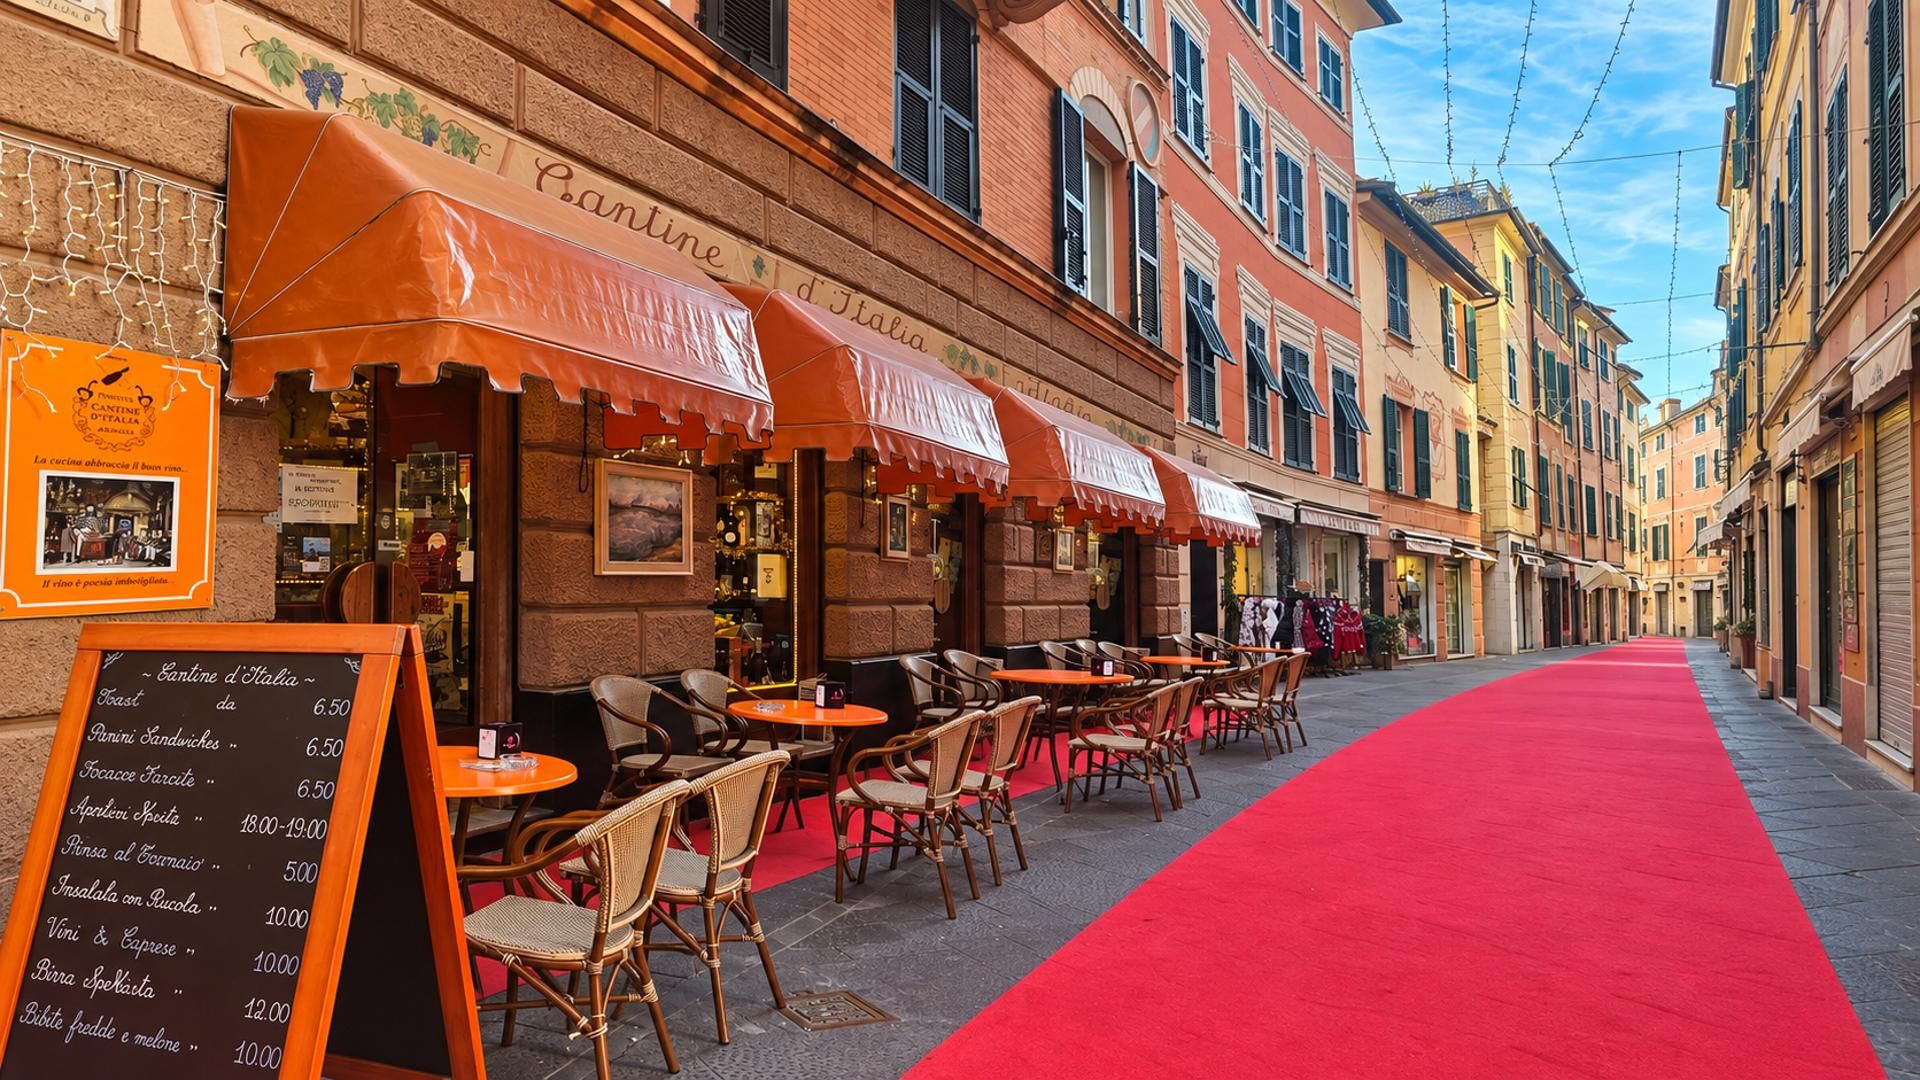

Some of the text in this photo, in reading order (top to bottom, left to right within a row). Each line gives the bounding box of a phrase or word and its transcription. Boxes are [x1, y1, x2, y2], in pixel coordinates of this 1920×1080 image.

[535, 157, 724, 269] Cantine
[90, 412, 140, 425] D'ITALIA
[91, 402, 140, 416] CANTINE
[34, 455, 47, 465] La
[156, 661, 218, 684] Cantine
[215, 694, 237, 711] da
[313, 697, 351, 717] 6.50
[139, 725, 220, 751] Sandwiches
[306, 736, 344, 758] 6.50
[296, 778, 335, 800] 6.50
[113, 841, 137, 862] al
[283, 860, 319, 884] 5.00
[121, 894, 144, 907] con
[145, 887, 202, 915] Rucola
[265, 905, 309, 929] 10.00
[46, 916, 81, 942] Vini
[253, 950, 300, 976] 10.00
[30, 957, 76, 986] Birra
[244, 997, 291, 1024] 12.00
[120, 1031, 130, 1044] e
[134, 1027, 180, 1053] melone
[233, 1040, 282, 1070] 10.00
